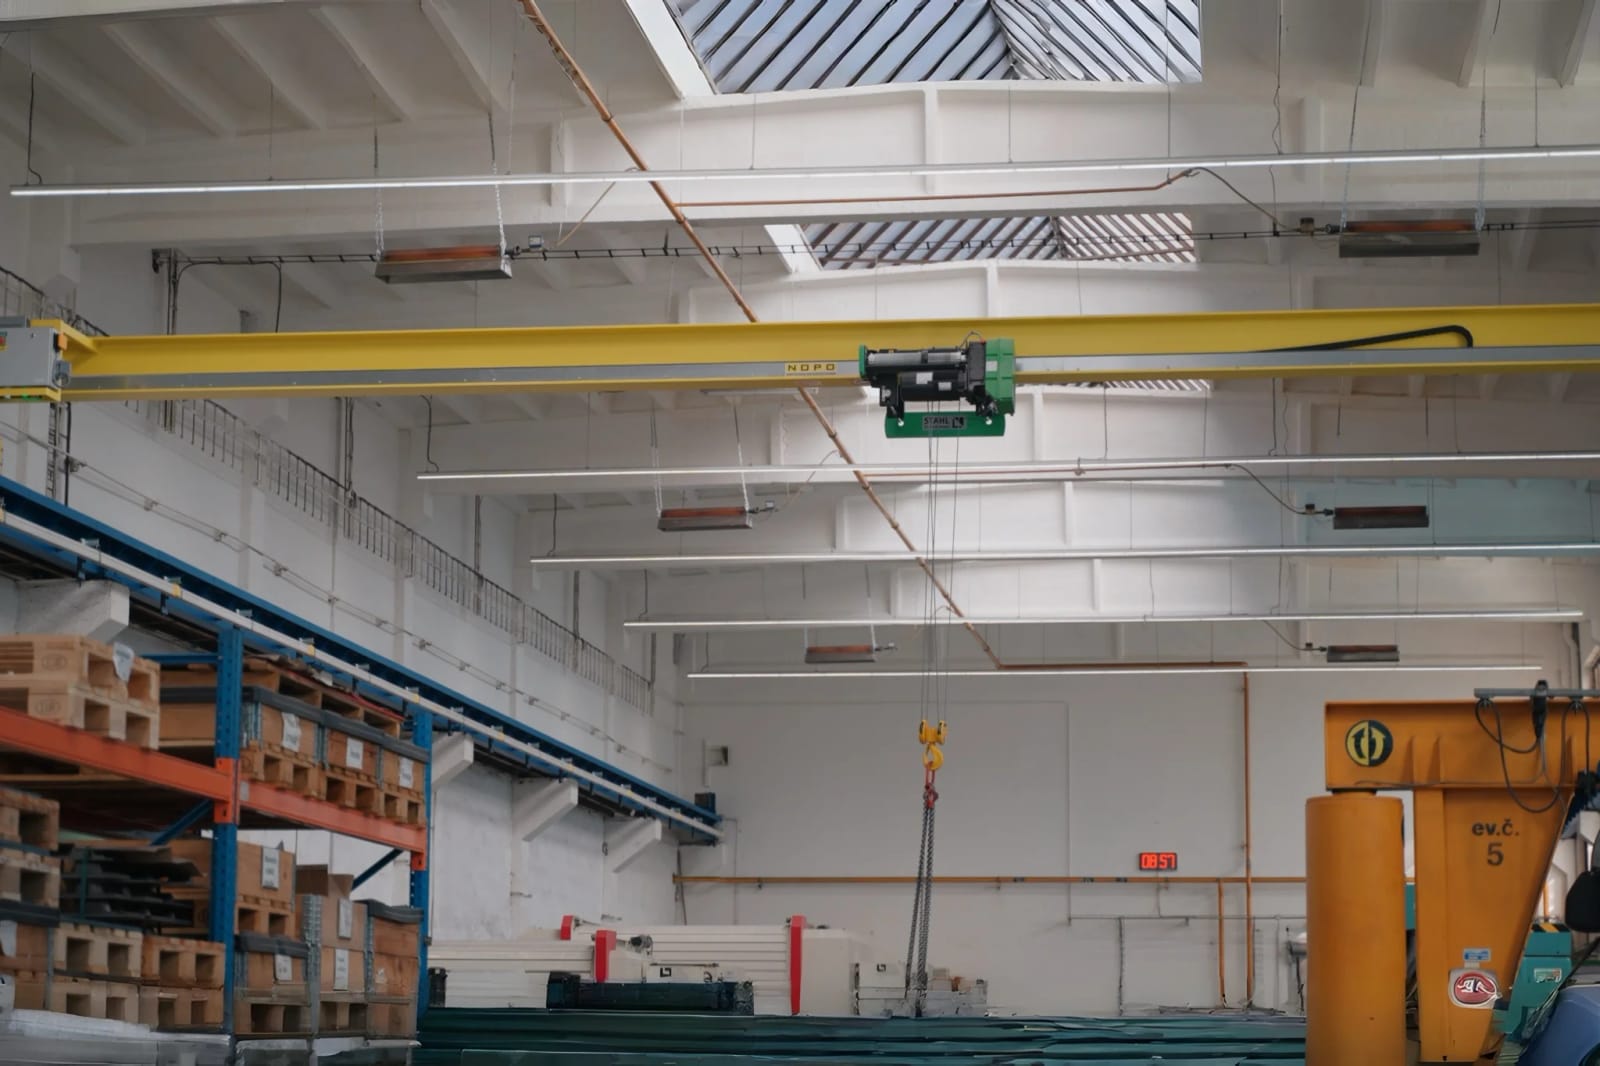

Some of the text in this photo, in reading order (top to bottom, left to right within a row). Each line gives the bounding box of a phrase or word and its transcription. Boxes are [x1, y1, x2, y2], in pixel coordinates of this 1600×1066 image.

[787, 363, 836, 372] NOPO
[924, 416, 950, 425] STAHL
[1487, 842, 1504, 866] 5
